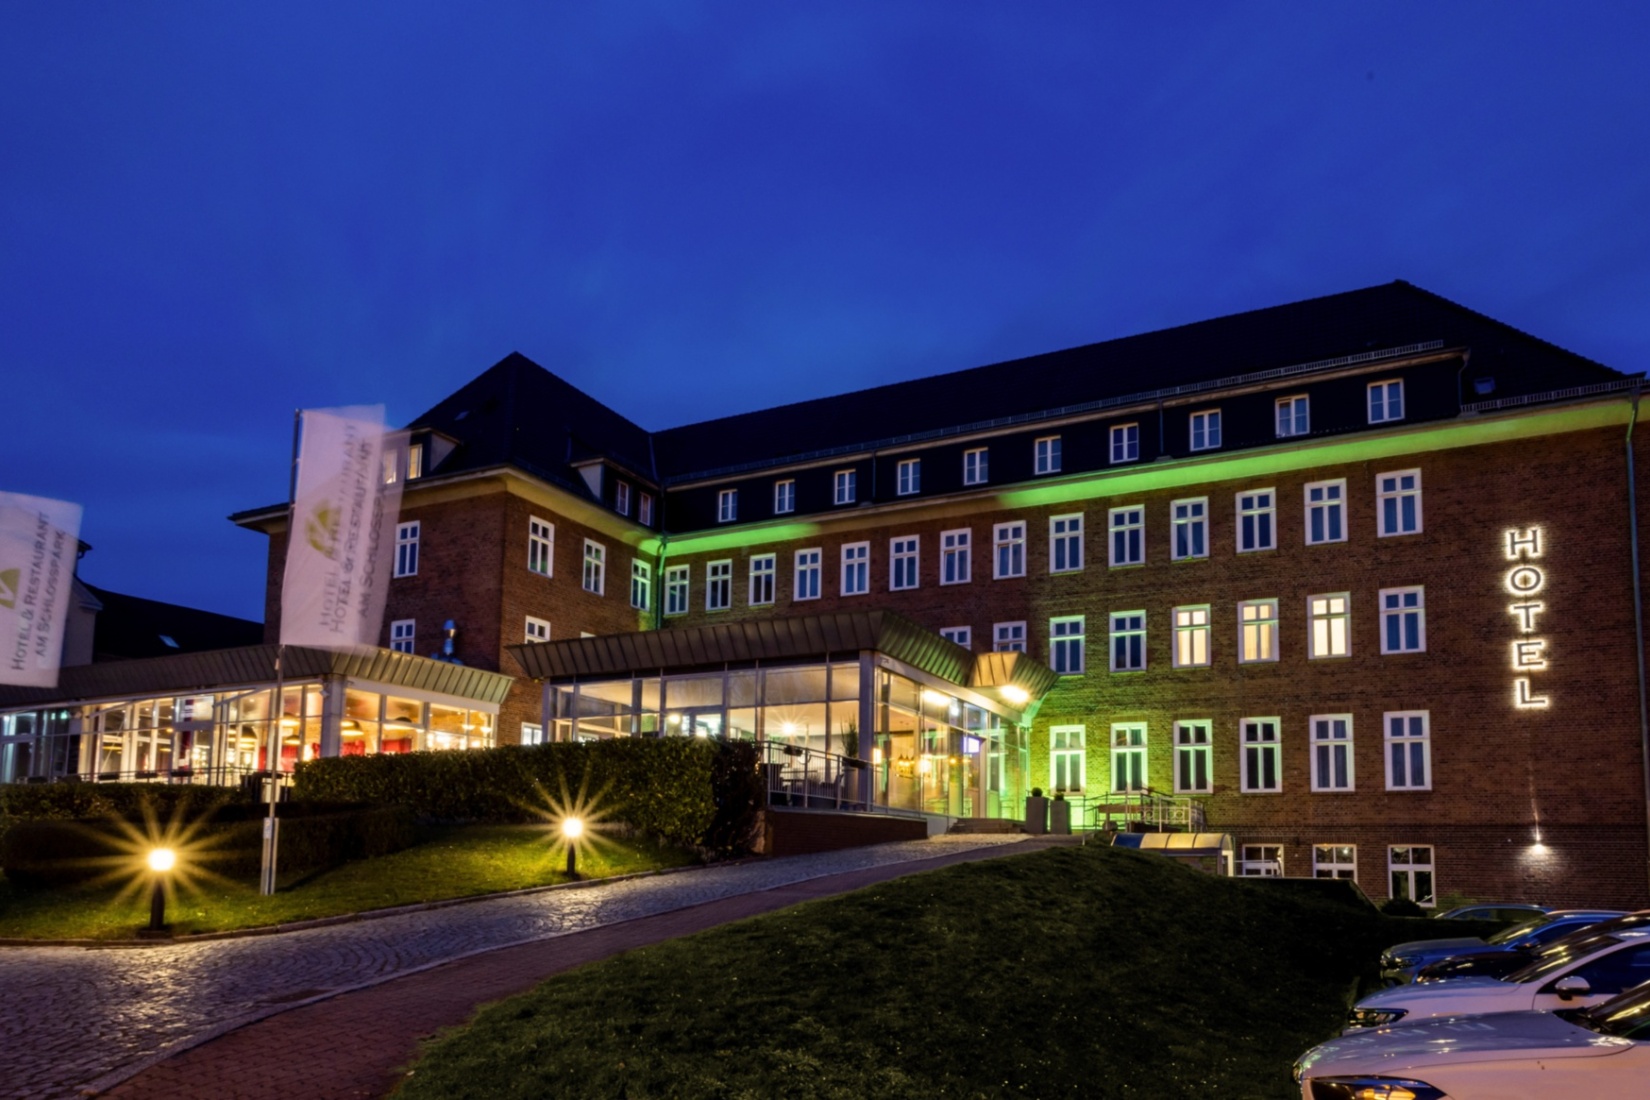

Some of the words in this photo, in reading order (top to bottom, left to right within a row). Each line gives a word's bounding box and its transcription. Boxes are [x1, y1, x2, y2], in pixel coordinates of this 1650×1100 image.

[24, 511, 50, 606] RESTAURANT
[37, 529, 66, 633] SCHLOSSPARK
[11, 623, 32, 671] HOTEL
[21, 608, 34, 621] &
[35, 635, 48, 657] AM
[1506, 527, 1548, 706] HOTEL
